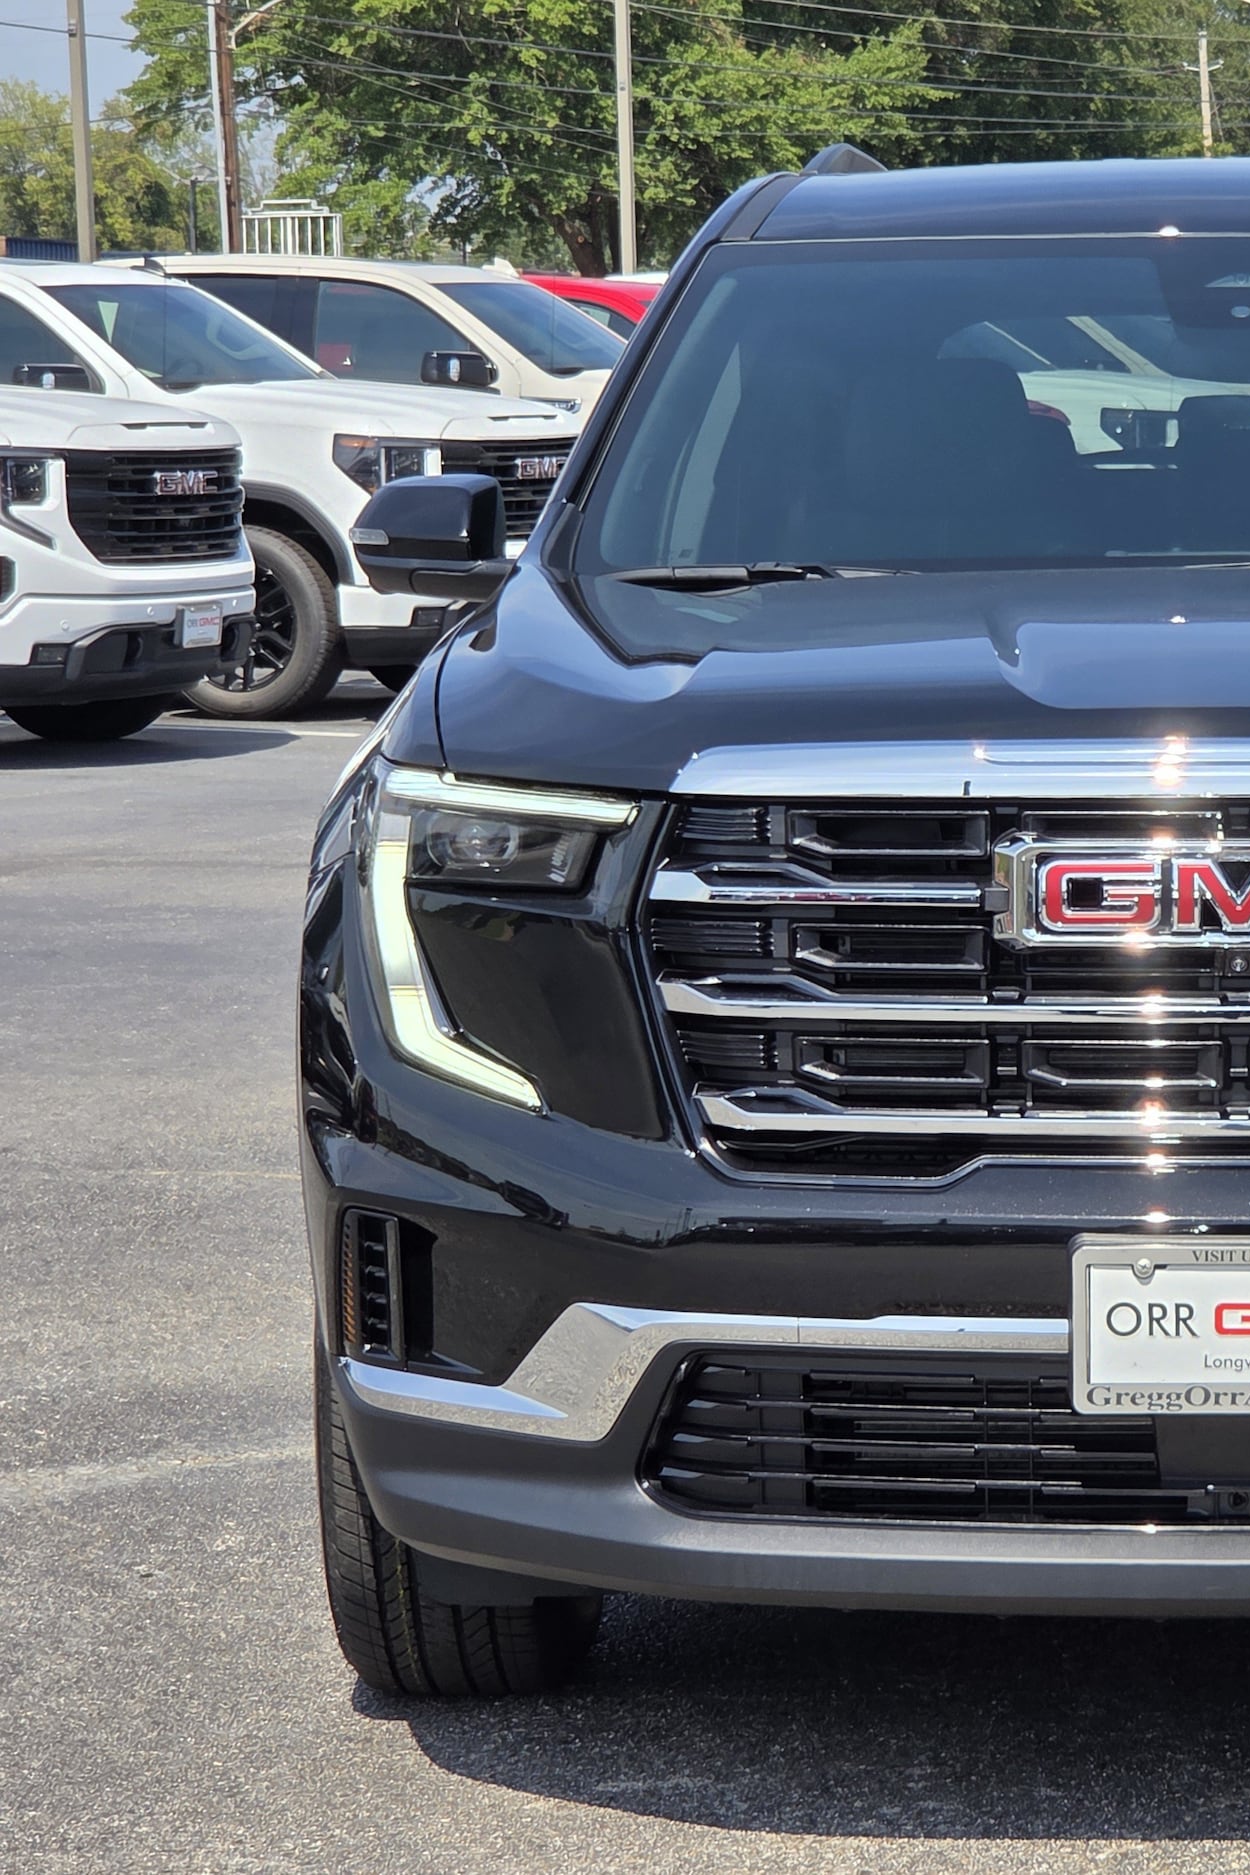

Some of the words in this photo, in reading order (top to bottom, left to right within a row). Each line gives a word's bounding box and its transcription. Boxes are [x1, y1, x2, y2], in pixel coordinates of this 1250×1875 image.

[157, 470, 218, 495] GMC
[1191, 1250, 1238, 1262] VISIT
[1106, 1302, 1200, 1337] ORR
